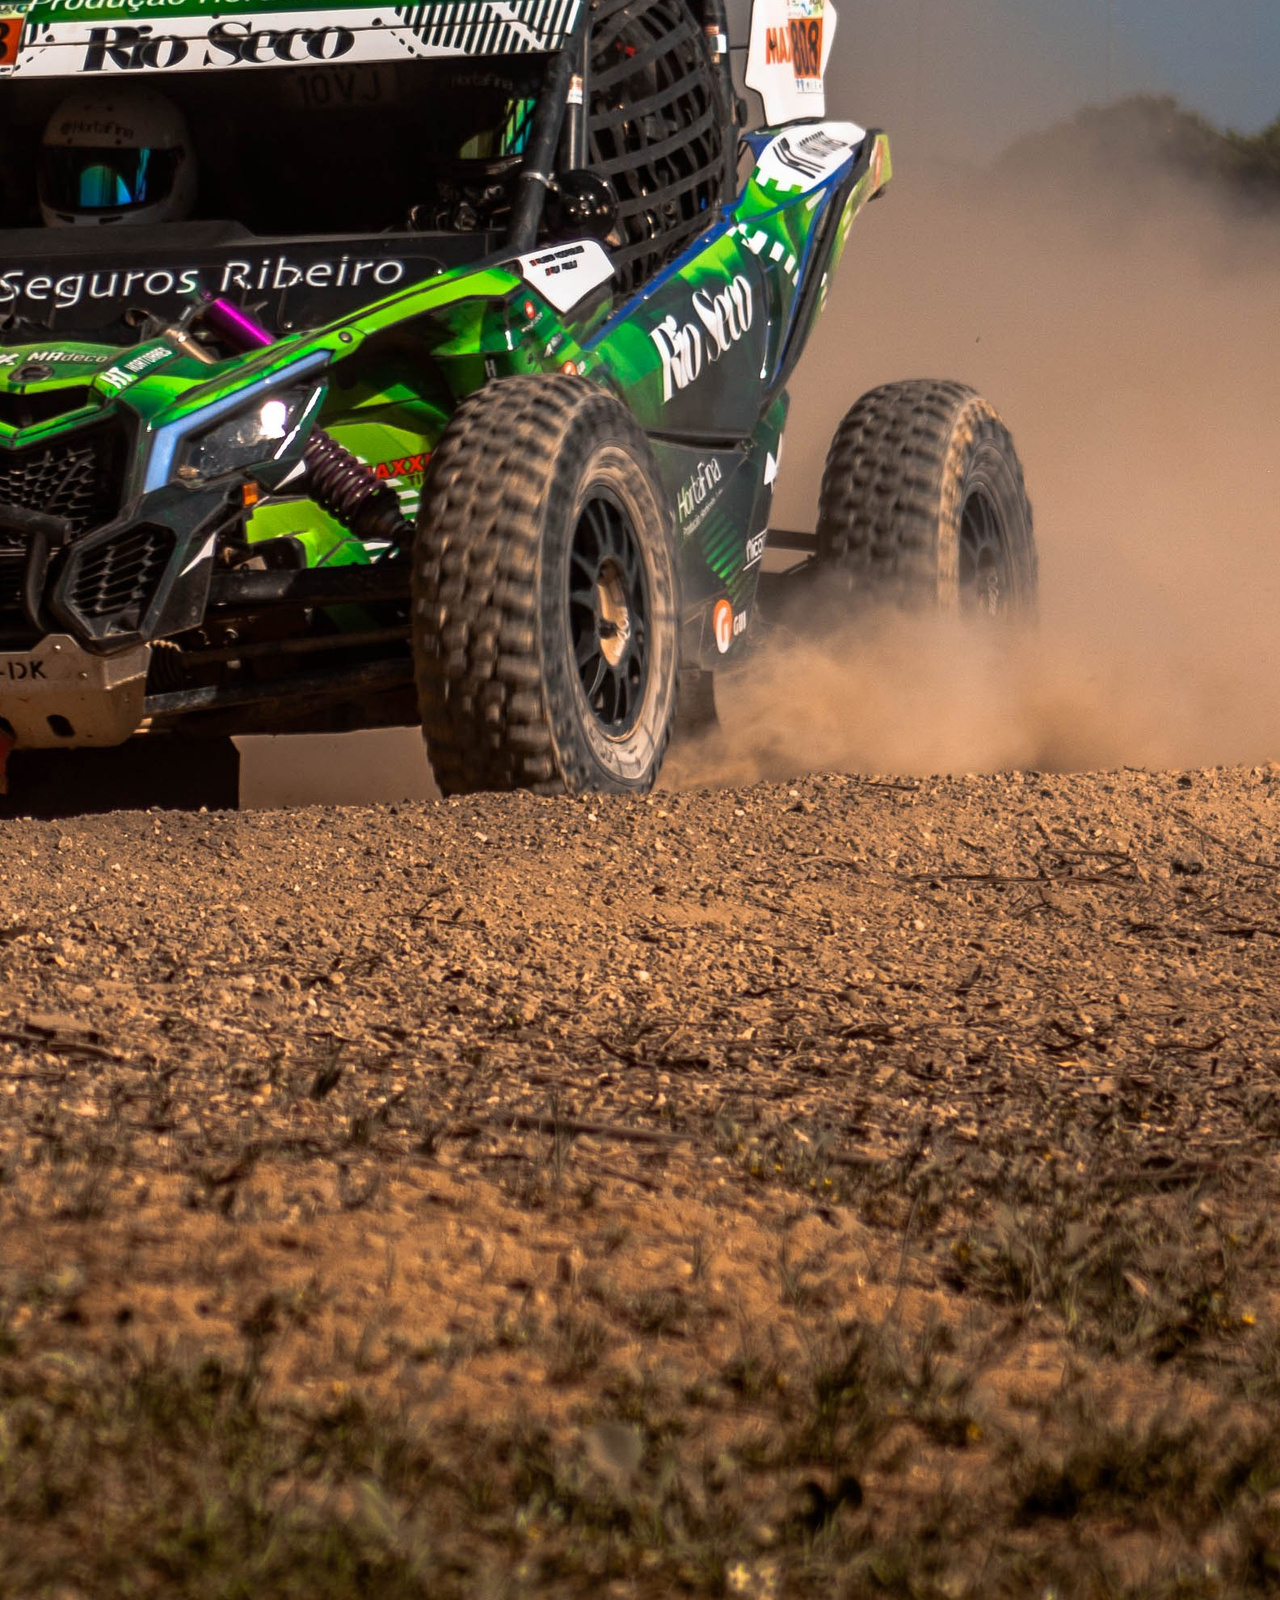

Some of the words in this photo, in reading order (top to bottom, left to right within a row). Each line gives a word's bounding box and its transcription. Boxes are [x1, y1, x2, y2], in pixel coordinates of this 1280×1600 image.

[77, 24, 188, 72] Rio
[203, 20, 355, 66] Seco
[790, 21, 819, 76] 808
[220, 257, 406, 293] Ribeiro
[650, 313, 702, 402] Rio
[691, 274, 754, 363] Seco
[100, 367, 133, 390] HT
[676, 457, 723, 523] HortaFina
